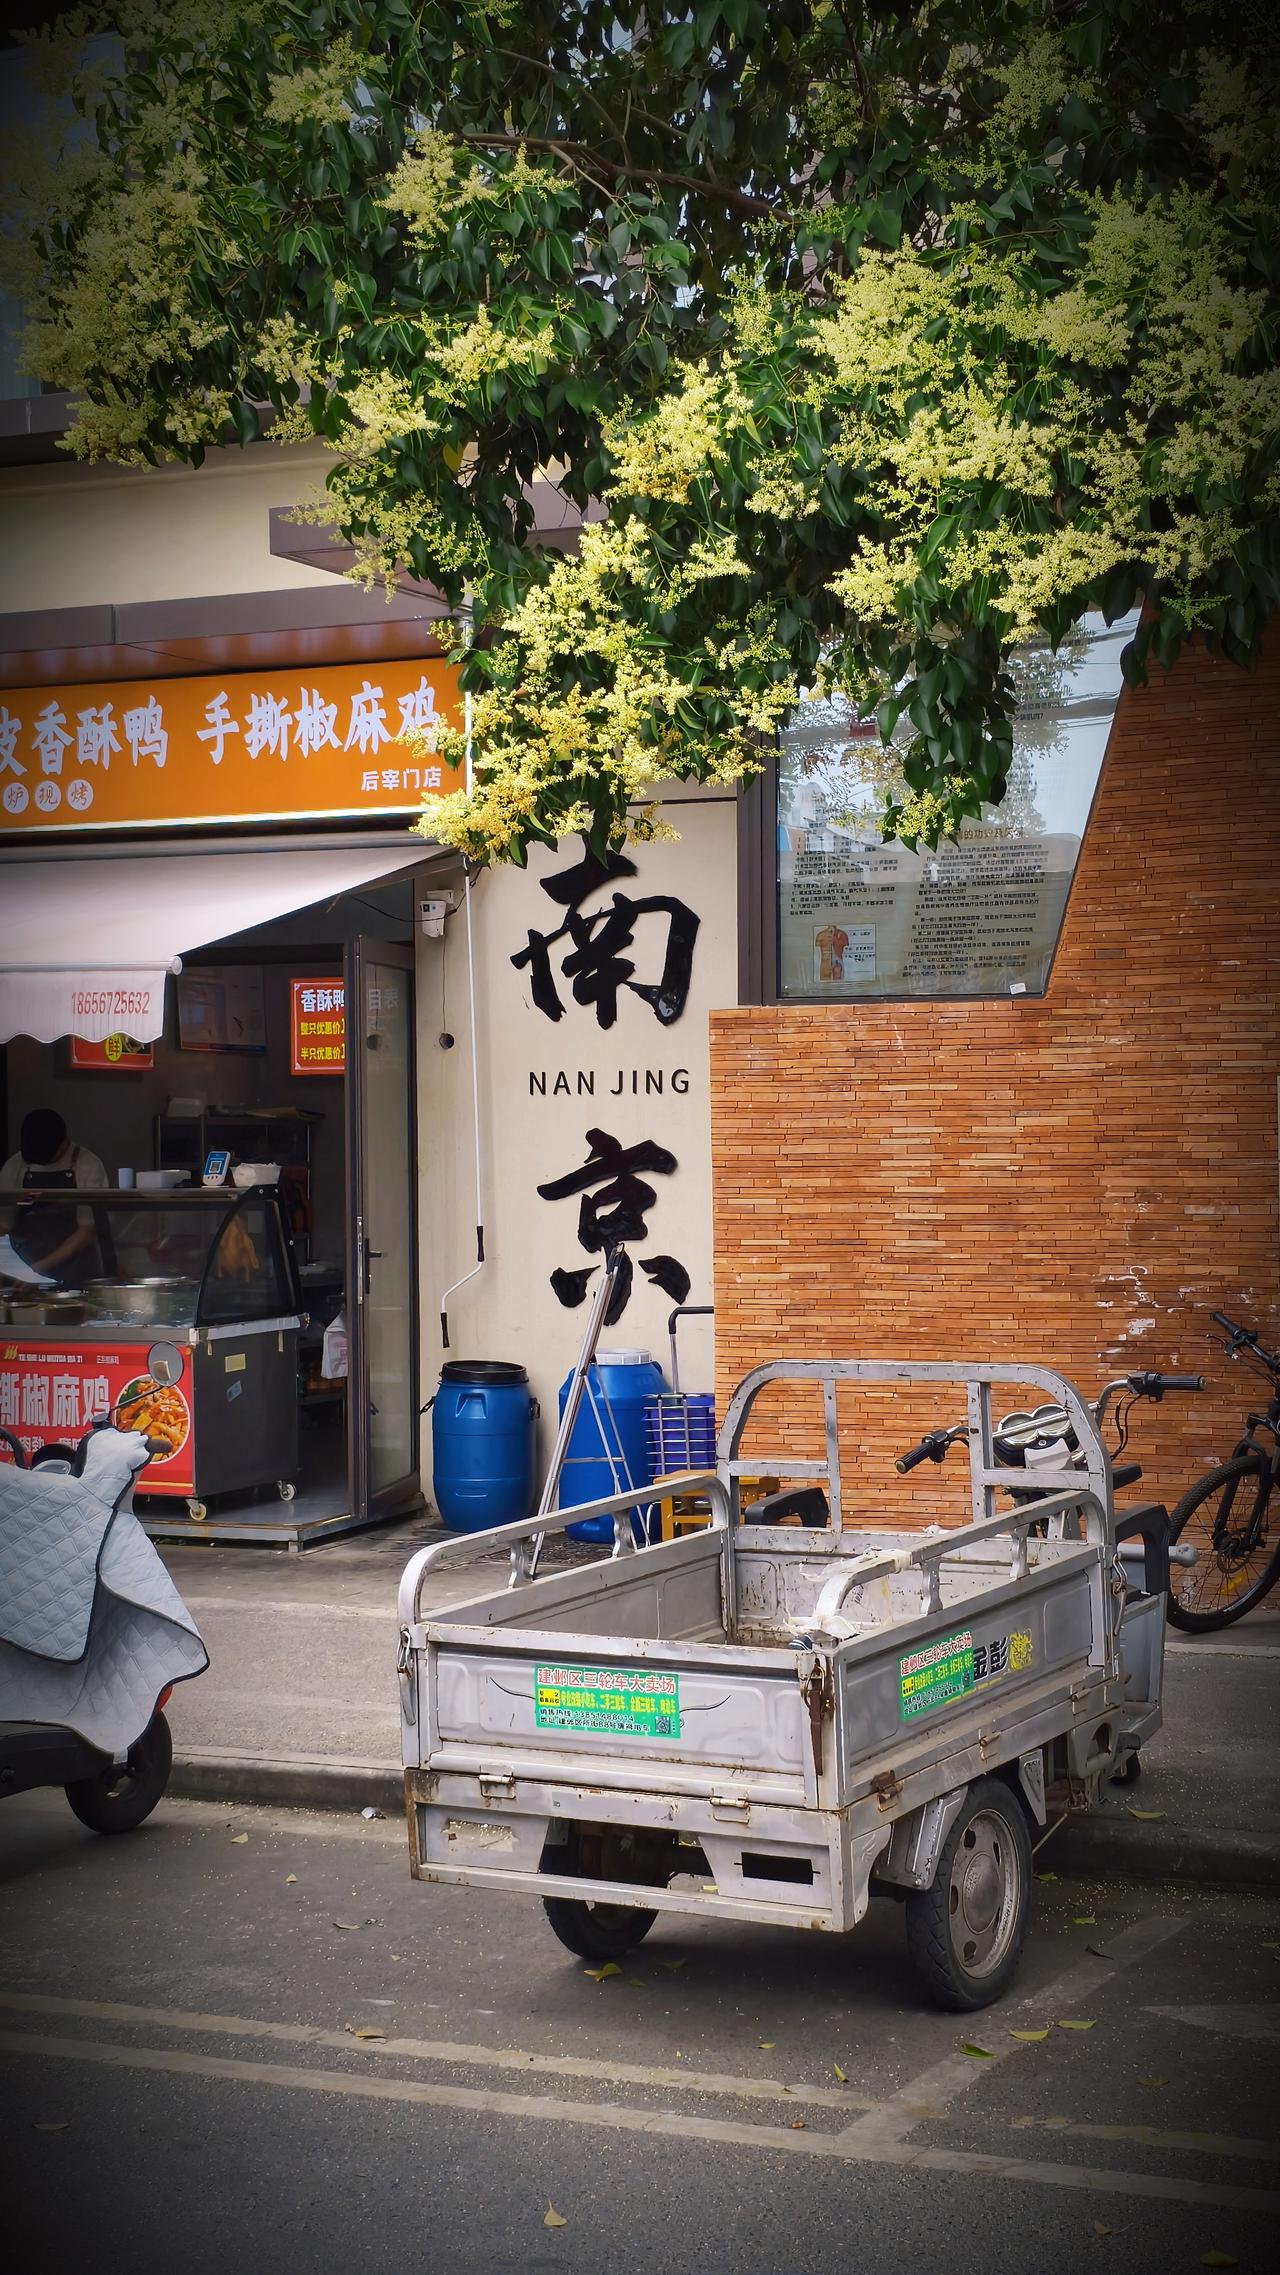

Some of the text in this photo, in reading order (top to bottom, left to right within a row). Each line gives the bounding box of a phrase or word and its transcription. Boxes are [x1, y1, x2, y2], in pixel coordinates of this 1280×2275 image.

[196, 675, 441, 765] 手撕椒麻鸡
[361, 766, 442, 792] 后宰门店
[71, 991, 150, 1015] 18656725632
[529, 1068, 690, 1096] NAN JING
[537, 1667, 676, 1694] 建邺区三轮车大卖场
